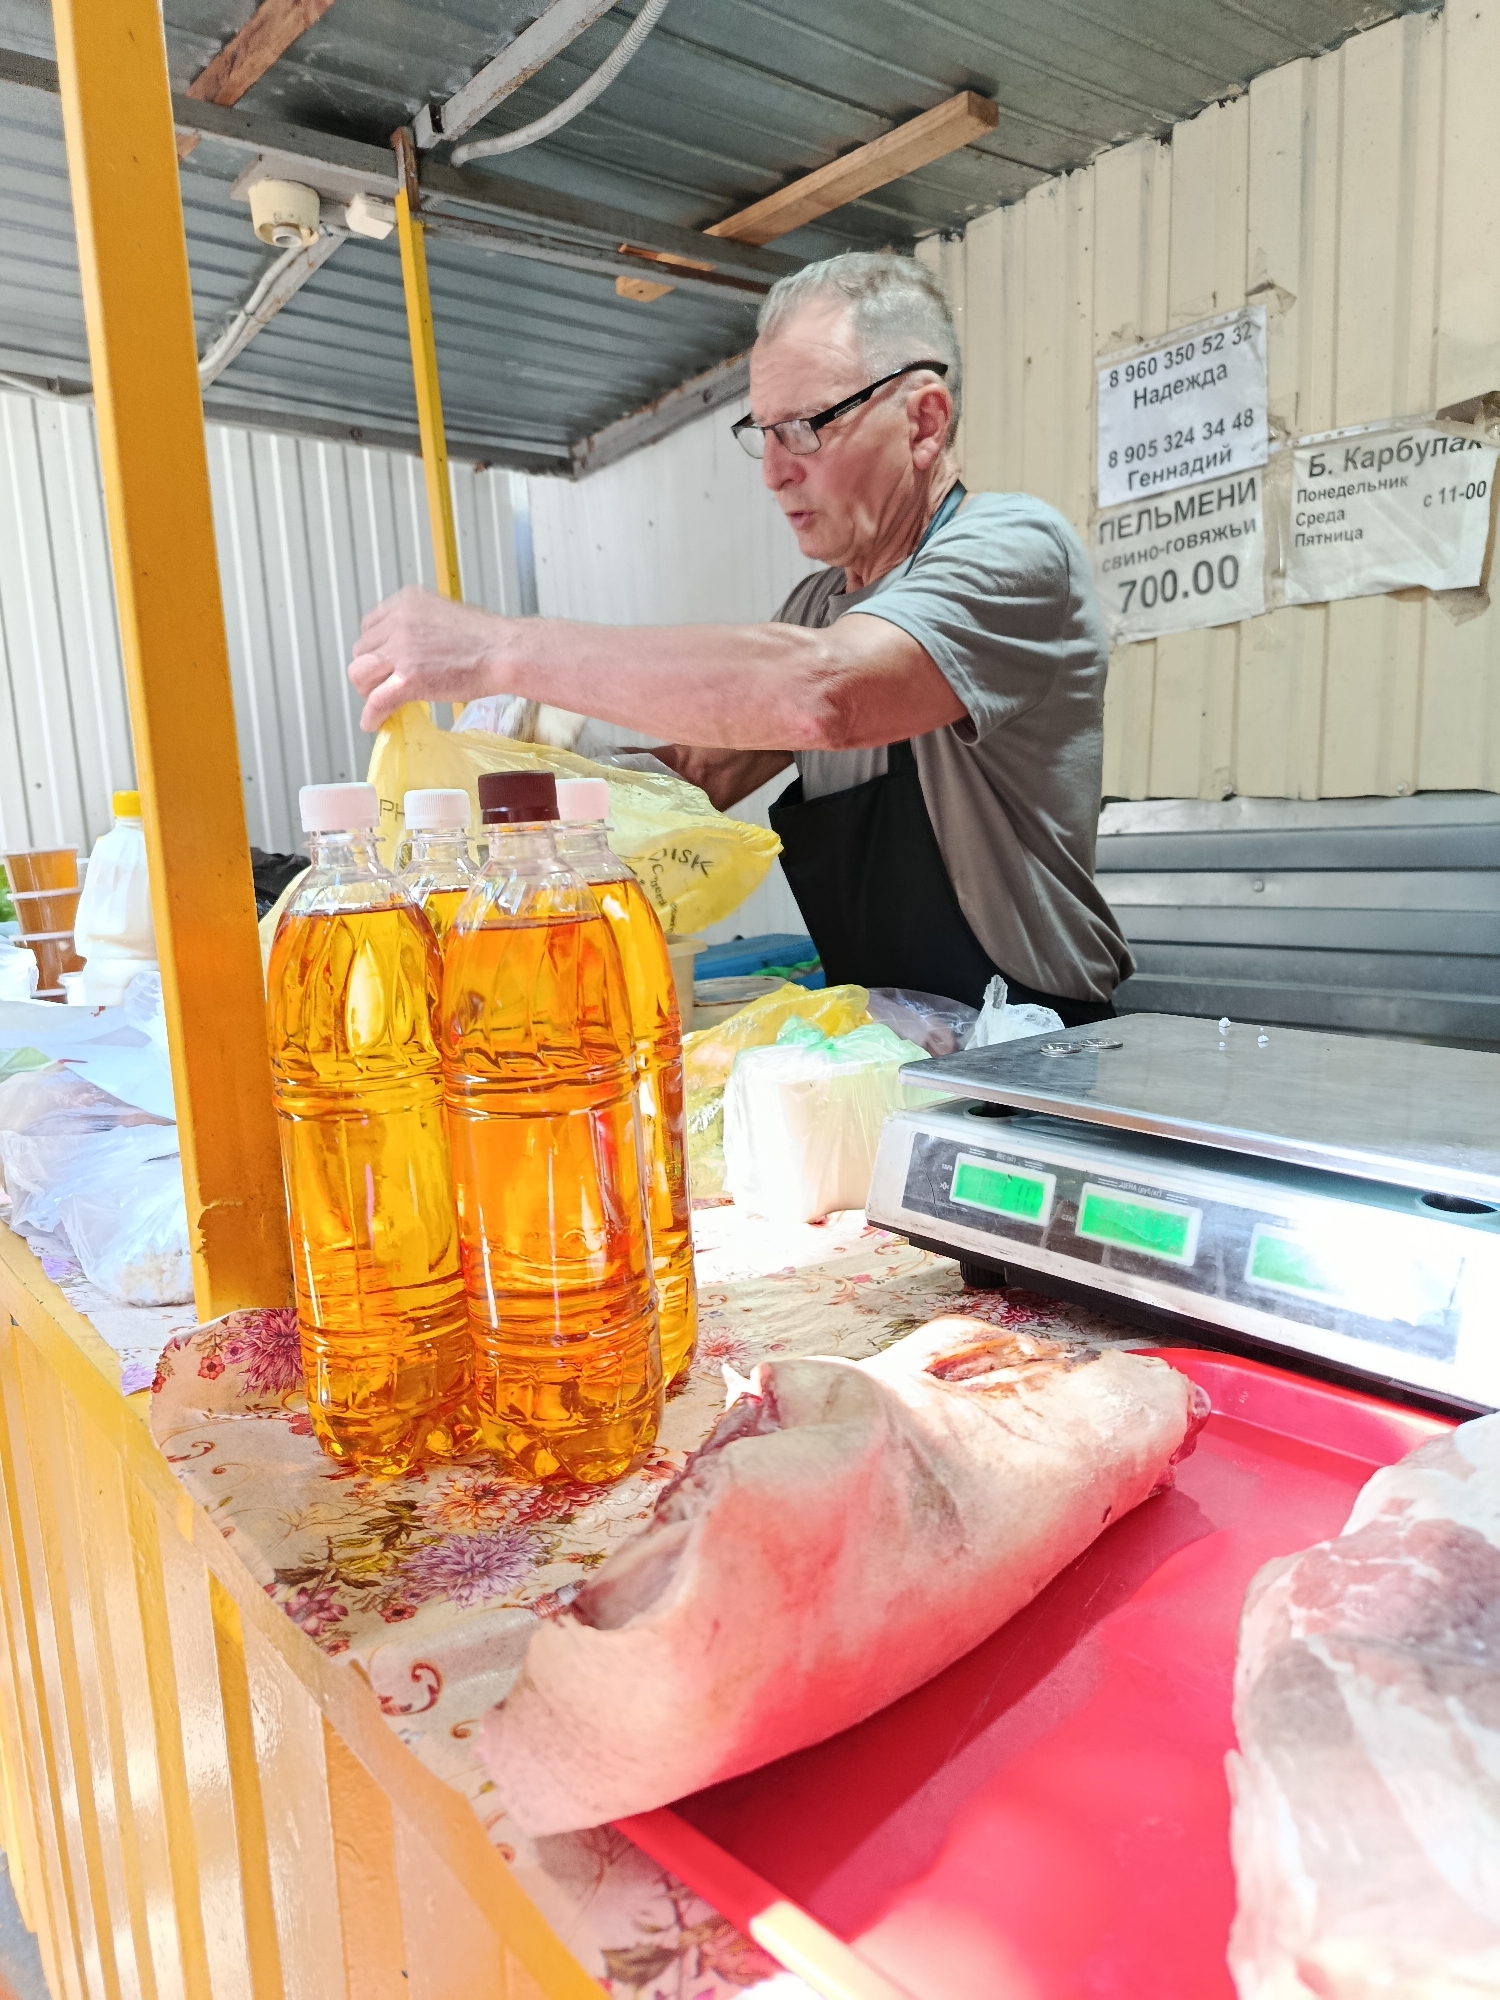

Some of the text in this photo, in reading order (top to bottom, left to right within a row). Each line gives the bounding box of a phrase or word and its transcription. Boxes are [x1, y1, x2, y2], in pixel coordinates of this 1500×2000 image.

[1109, 321, 1252, 388] 8 960 350 52 32
[1133, 363, 1228, 409] Надежда
[1108, 408, 1254, 469] 8 905 324 34 48
[1127, 444, 1232, 491] Геннадий
[1308, 453, 1333, 478] Б.
[1098, 477, 1257, 545] ПЕЛЬМЕНИ
[1296, 476, 1409, 504] Понедельник
[1422, 480, 1487, 508] с 11-00
[1294, 528, 1363, 548] Пятница
[1295, 509, 1345, 529] Среда
[1101, 518, 1257, 573] свино-говяжьи
[1117, 554, 1239, 614] 700.00
[1120, 1181, 1137, 1192] ЦЕНА
